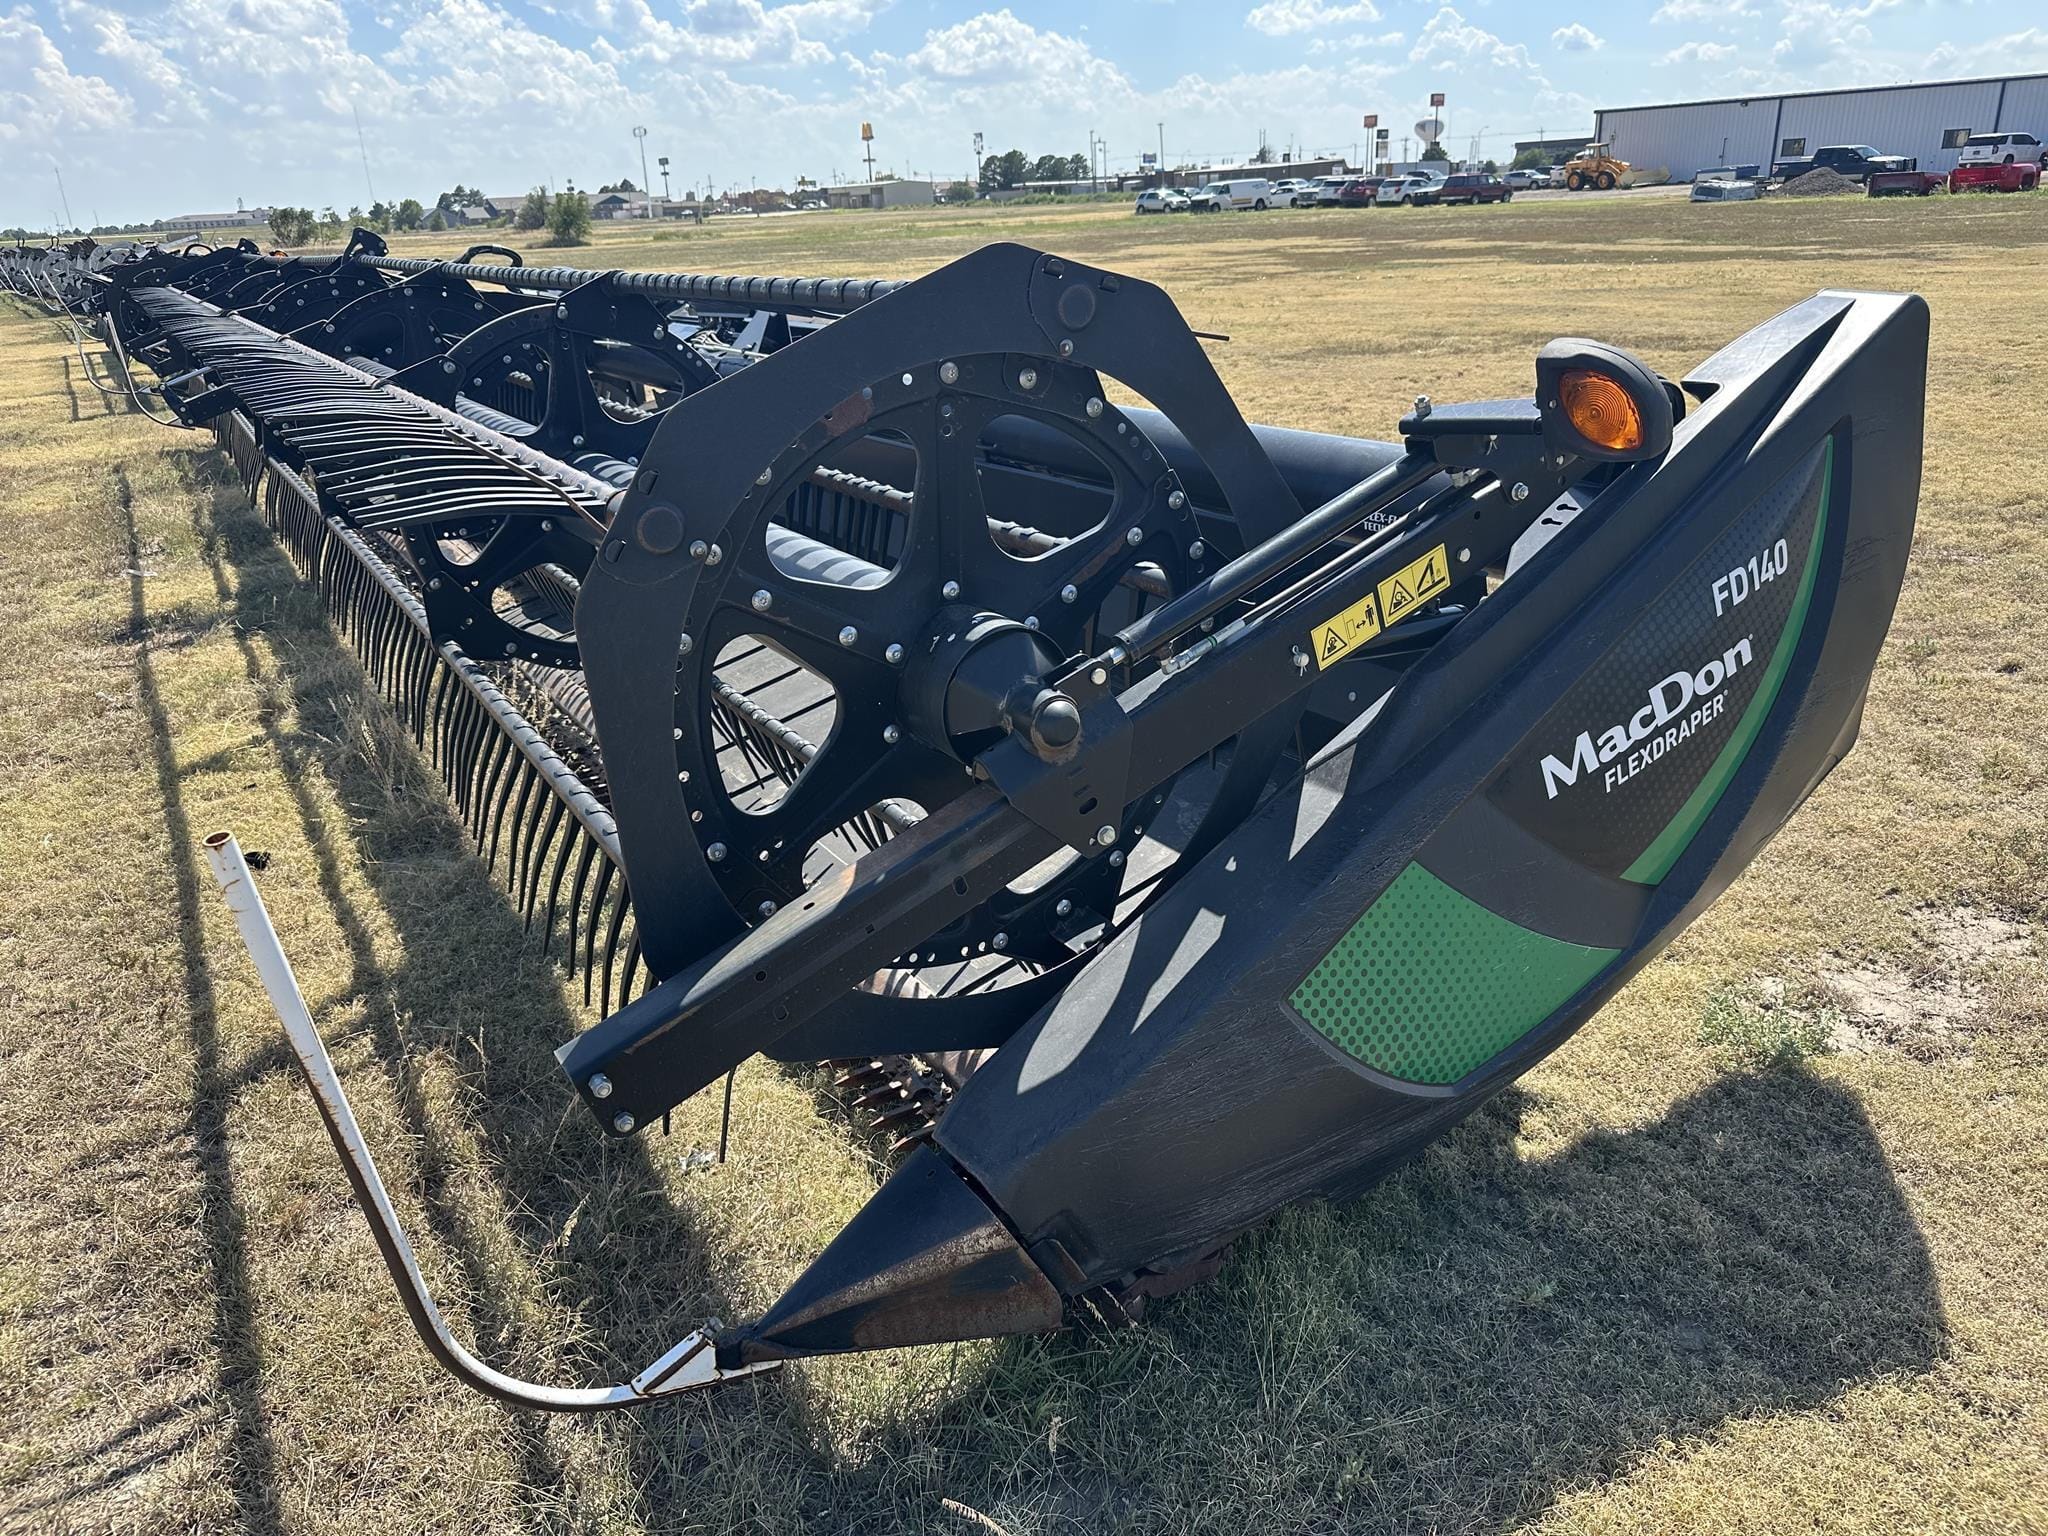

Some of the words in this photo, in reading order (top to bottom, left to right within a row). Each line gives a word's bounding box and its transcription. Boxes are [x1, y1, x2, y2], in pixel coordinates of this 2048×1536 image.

[1711, 538, 1789, 617] FD140
[1540, 637, 1753, 800] MacDon
[1604, 693, 1724, 794] FLEXDRAPER
